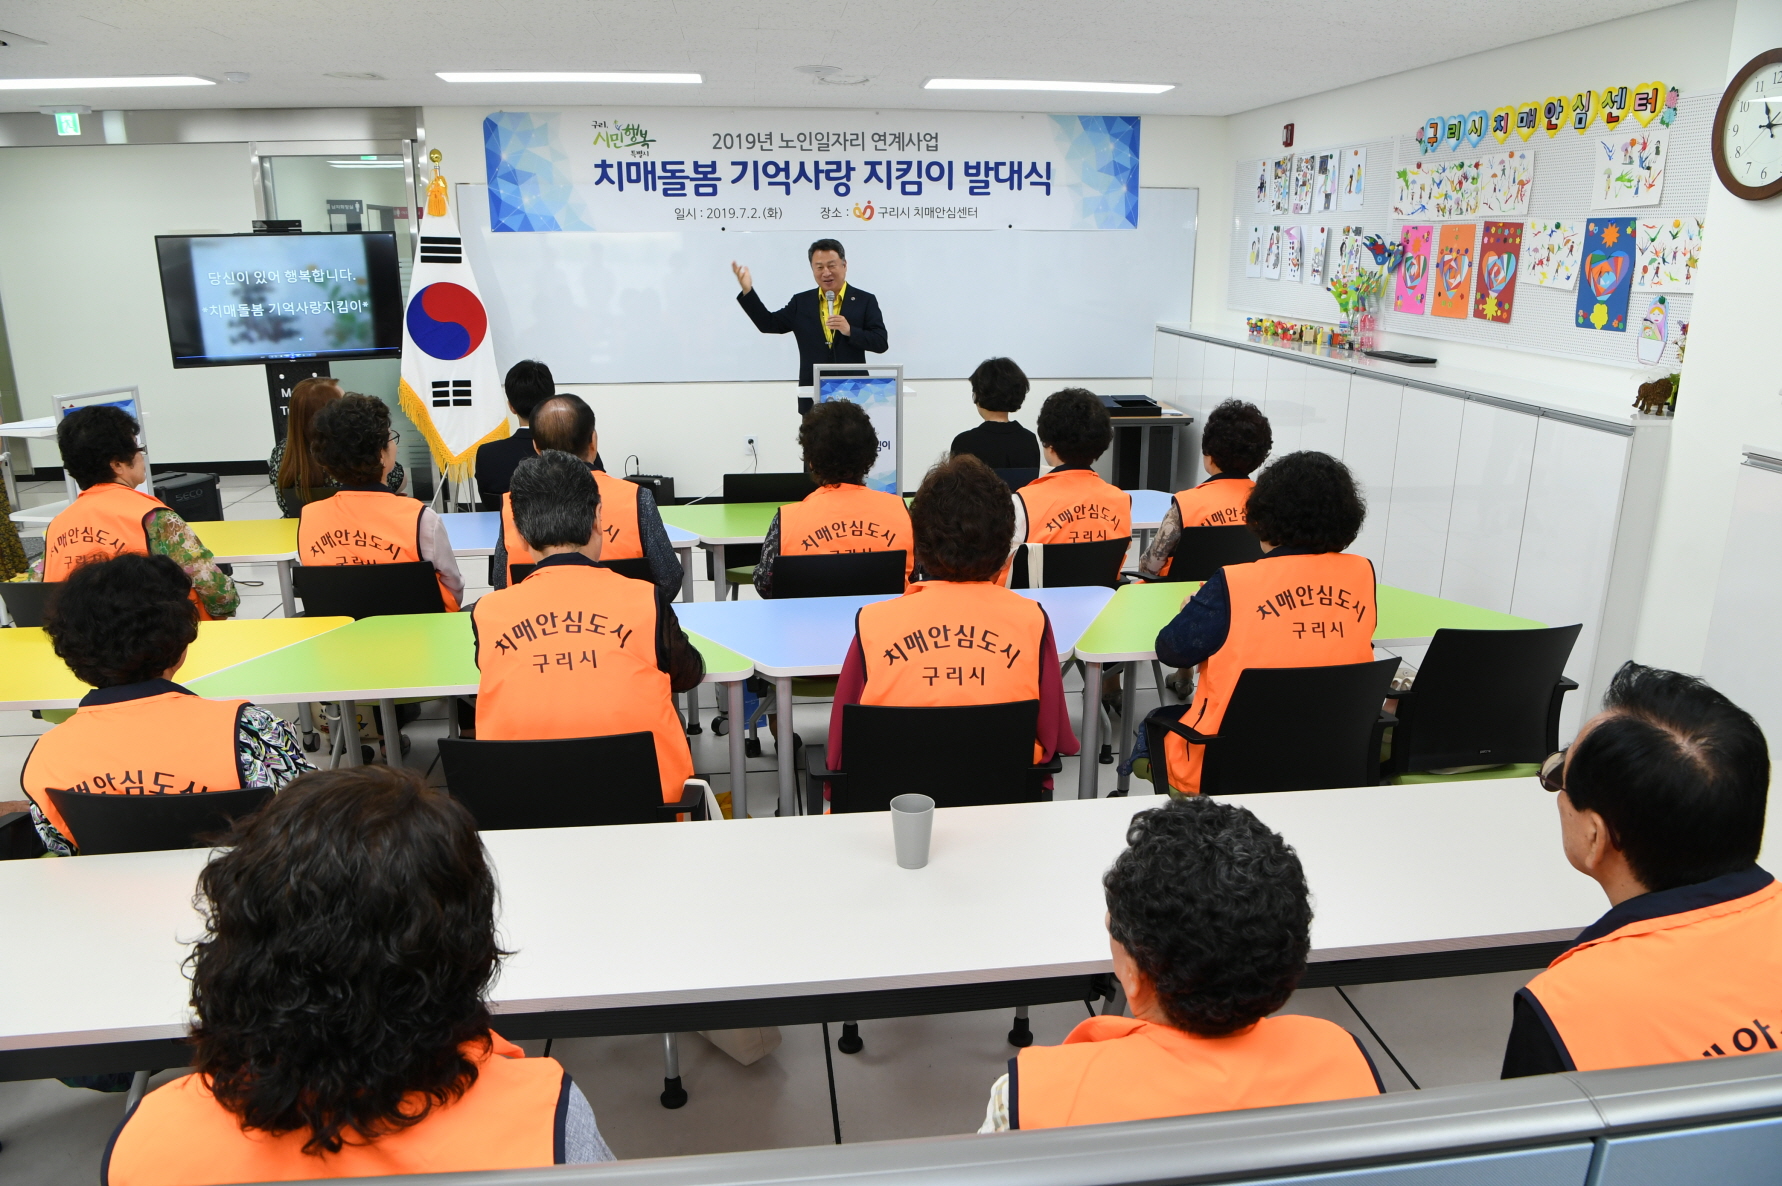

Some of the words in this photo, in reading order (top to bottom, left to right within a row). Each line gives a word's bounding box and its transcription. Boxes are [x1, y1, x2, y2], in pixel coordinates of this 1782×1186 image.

[1755, 81, 1764, 92] 11
[1739, 100, 1750, 113] 10
[1732, 124, 1739, 137] 9
[712, 132, 773, 151] 2019년
[778, 132, 865, 151] 노인일자리
[871, 132, 939, 151] 연계사업
[1735, 146, 1741, 158] 8
[1745, 162, 1752, 174] 7
[1760, 167, 1767, 179] 6
[594, 159, 722, 197] 치매돌봄
[730, 160, 856, 197] 기억사랑
[863, 160, 954, 196] 지킴이
[964, 160, 1051, 196] 발대식
[674, 207, 696, 220] 일시
[706, 207, 783, 220] 2019.7.2.(화)
[820, 206, 842, 219] 장소
[878, 206, 910, 219] 구리시
[913, 206, 978, 219] 치매안심센터
[208, 270, 250, 285] 당신이
[253, 270, 281, 285] 있어
[284, 268, 356, 284] 행복합니다.
[175, 488, 203, 502] SECO
[1045, 503, 1120, 532] 치매안심도시
[310, 529, 401, 560] 치매안심도시
[801, 520, 896, 551] 치매안심도시
[1256, 585, 1366, 623] 치매안심도시
[494, 611, 632, 655] 치매안심도시
[1292, 621, 1344, 639] 구리시
[883, 624, 1021, 669] 치매안심도시
[532, 650, 597, 673] 구리시
[922, 666, 985, 686] 구리시
